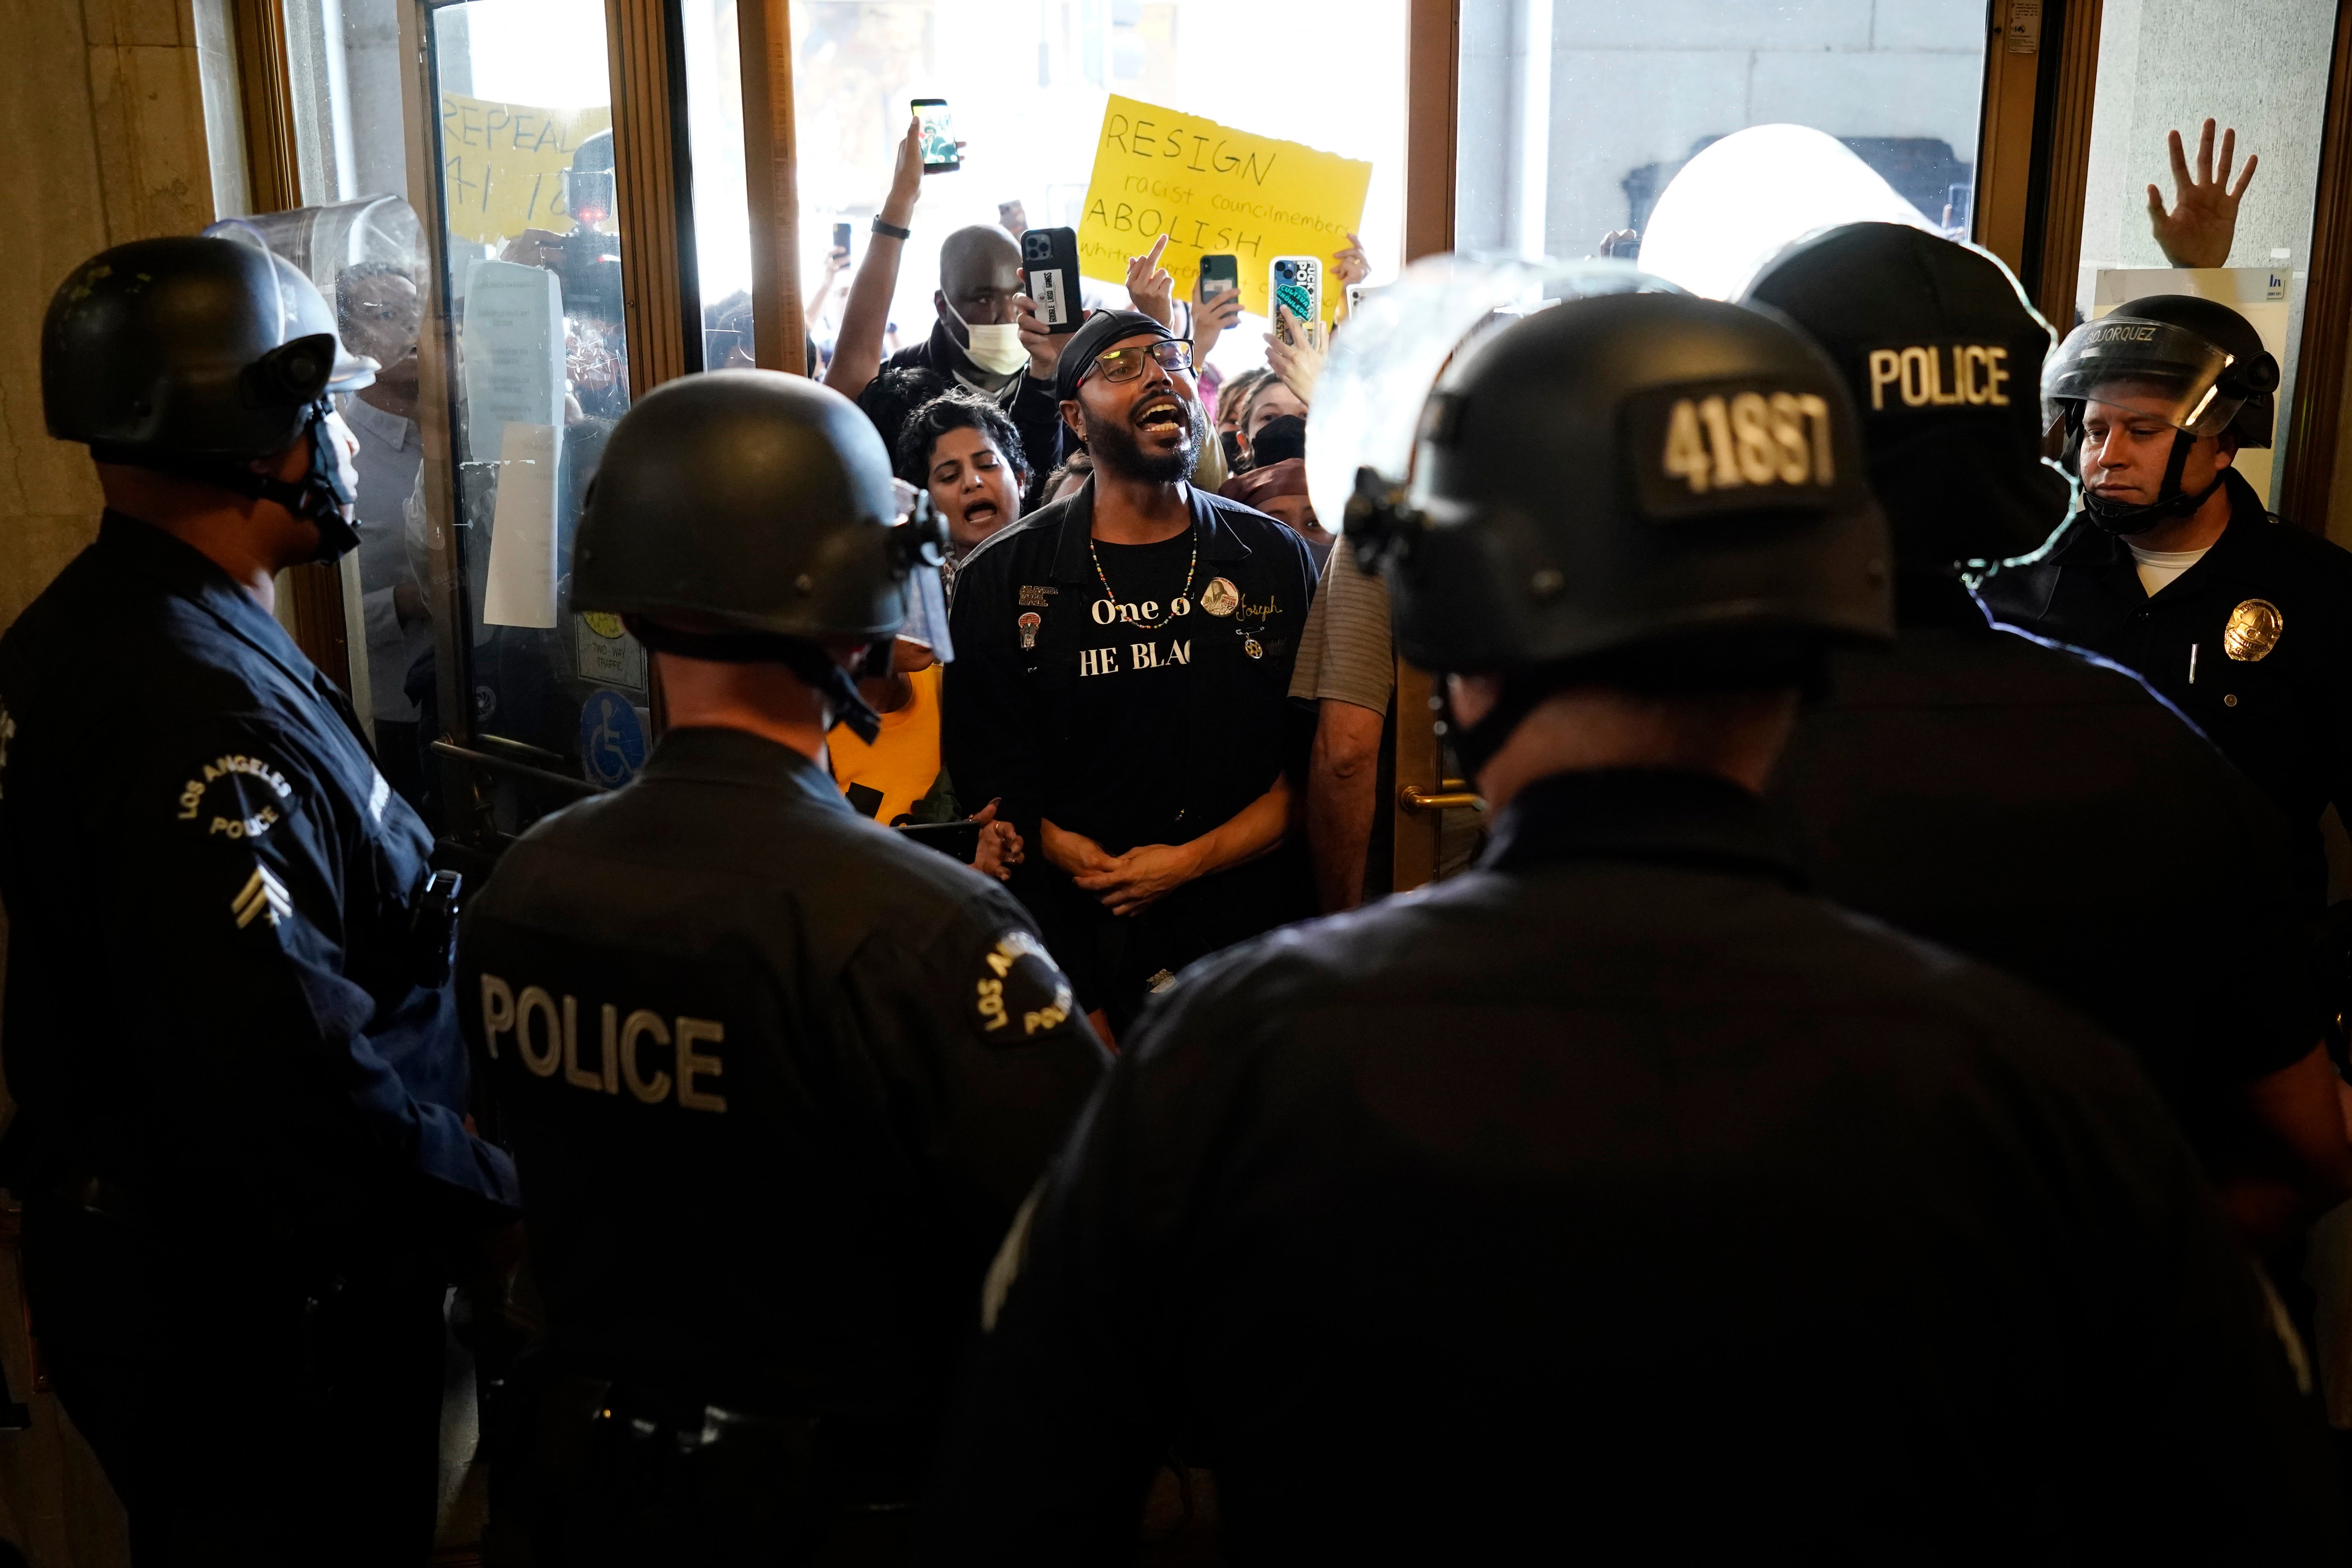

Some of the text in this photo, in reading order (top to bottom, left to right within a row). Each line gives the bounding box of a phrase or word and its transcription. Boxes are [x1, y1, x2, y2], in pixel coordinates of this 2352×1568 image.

[443, 99, 578, 153] REPEAL
[1106, 114, 1276, 186] RESIGN
[1124, 173, 1194, 205] racist
[1087, 199, 1262, 257] ABOLISH
[1044, 272, 1054, 288] GANGS
[1296, 261, 1308, 286] POL
[1047, 305, 1057, 322] GOOGLE
[2085, 327, 2157, 345] BOJORQUEZ
[1869, 345, 2010, 411] POLICE
[1092, 597, 1190, 624] One o
[1236, 593, 1282, 622] Joseph
[1080, 639, 1191, 676] HE BLA
[177, 755, 292, 819] LOS ANGELES
[480, 973, 727, 1114] POLICE
